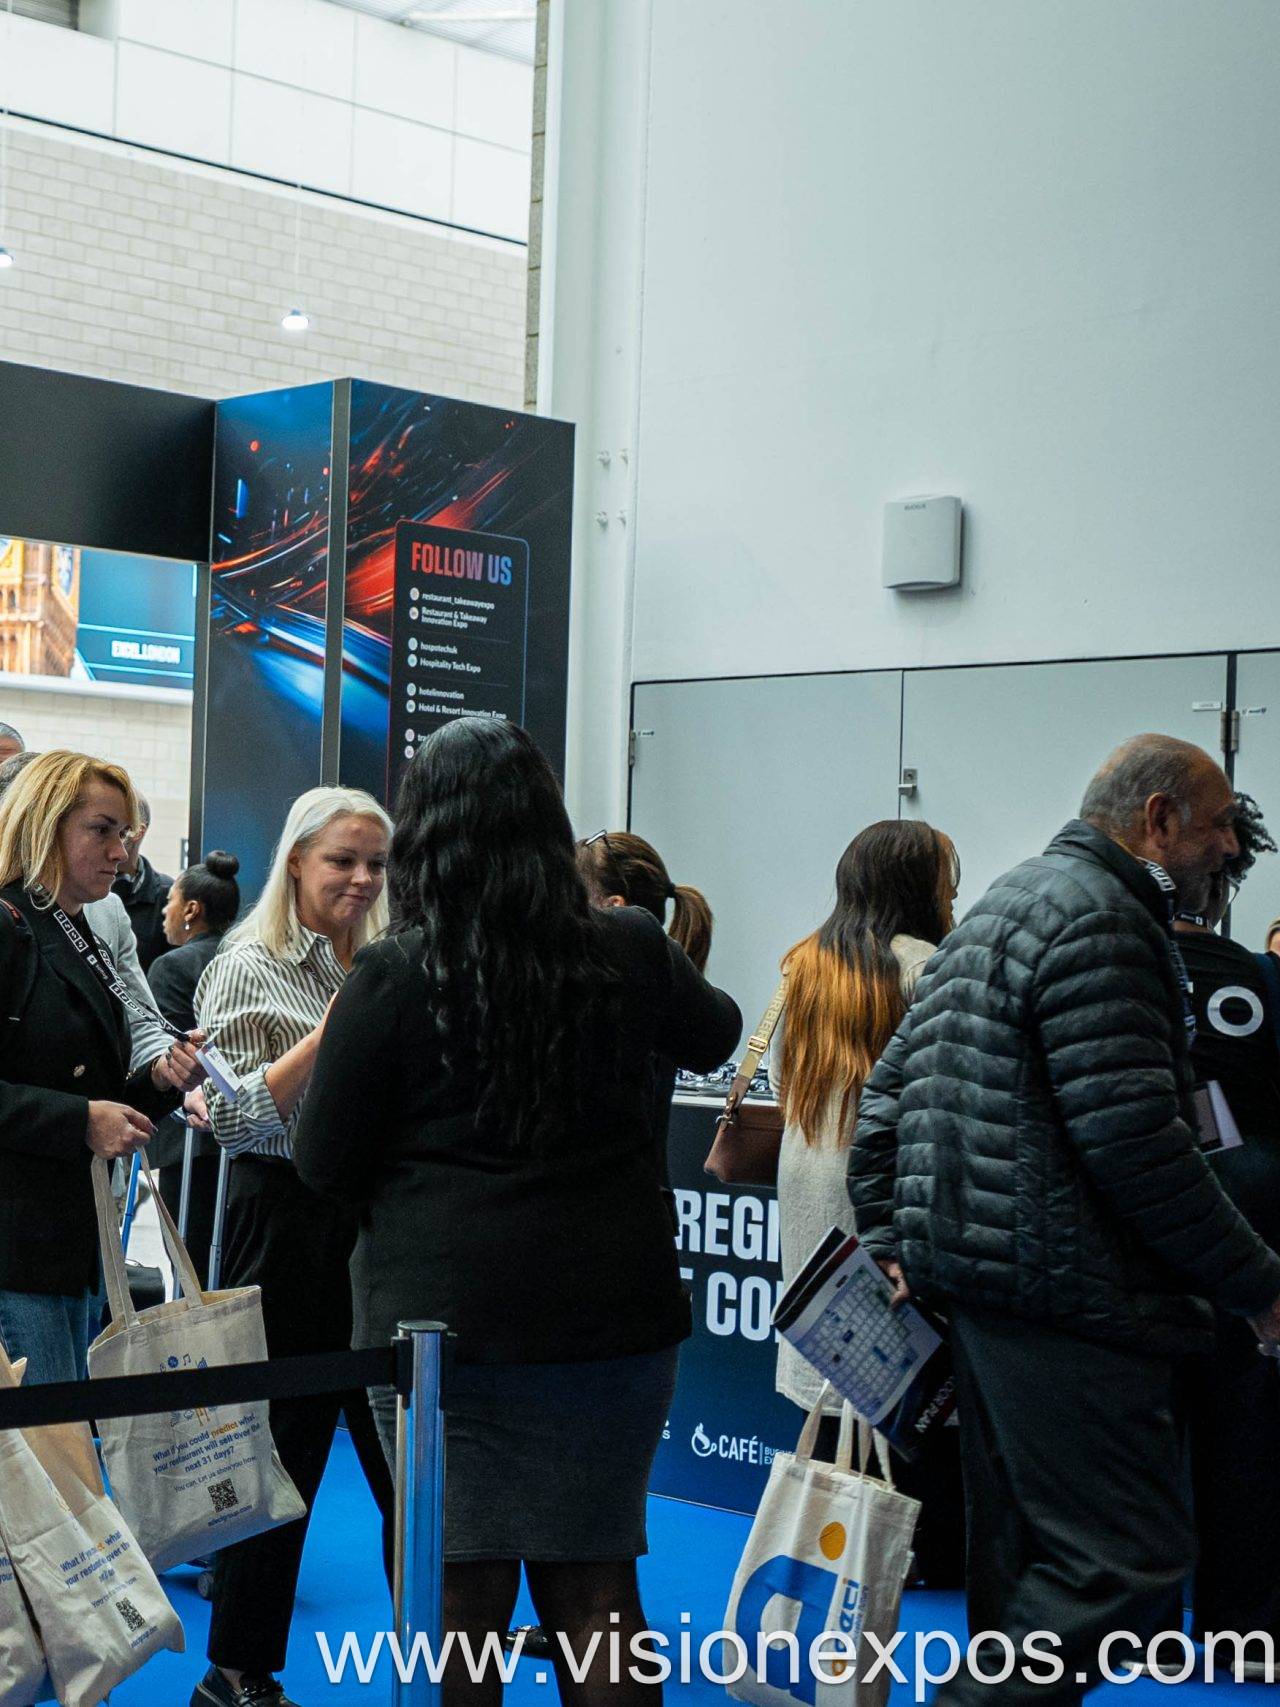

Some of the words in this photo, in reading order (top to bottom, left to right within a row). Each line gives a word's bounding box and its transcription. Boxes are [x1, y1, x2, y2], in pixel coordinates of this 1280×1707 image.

[411, 541, 483, 581] FOLLOW
[487, 554, 512, 586] US
[421, 606, 453, 619] Restaurant
[420, 658, 452, 671] Hospitality
[452, 661, 465, 671] Tech
[466, 663, 481, 673] Expo
[418, 703, 435, 713] Hotel
[153, 1449, 170, 1461] What
[176, 1441, 188, 1453] you
[189, 1431, 210, 1446] could
[211, 1421, 239, 1439] predict
[239, 1413, 256, 1425] what
[153, 1463, 170, 1476] your
[169, 1447, 204, 1468] restaurant
[204, 1442, 219, 1453] will
[219, 1435, 234, 1446] sell
[235, 1429, 251, 1440] over
[184, 1461, 201, 1473] next
[202, 1456, 212, 1465] 31
[213, 1446, 235, 1460] days?
[719, 1435, 759, 1464] CAFÉ
[174, 1483, 186, 1493] You
[60, 1556, 81, 1572] What
